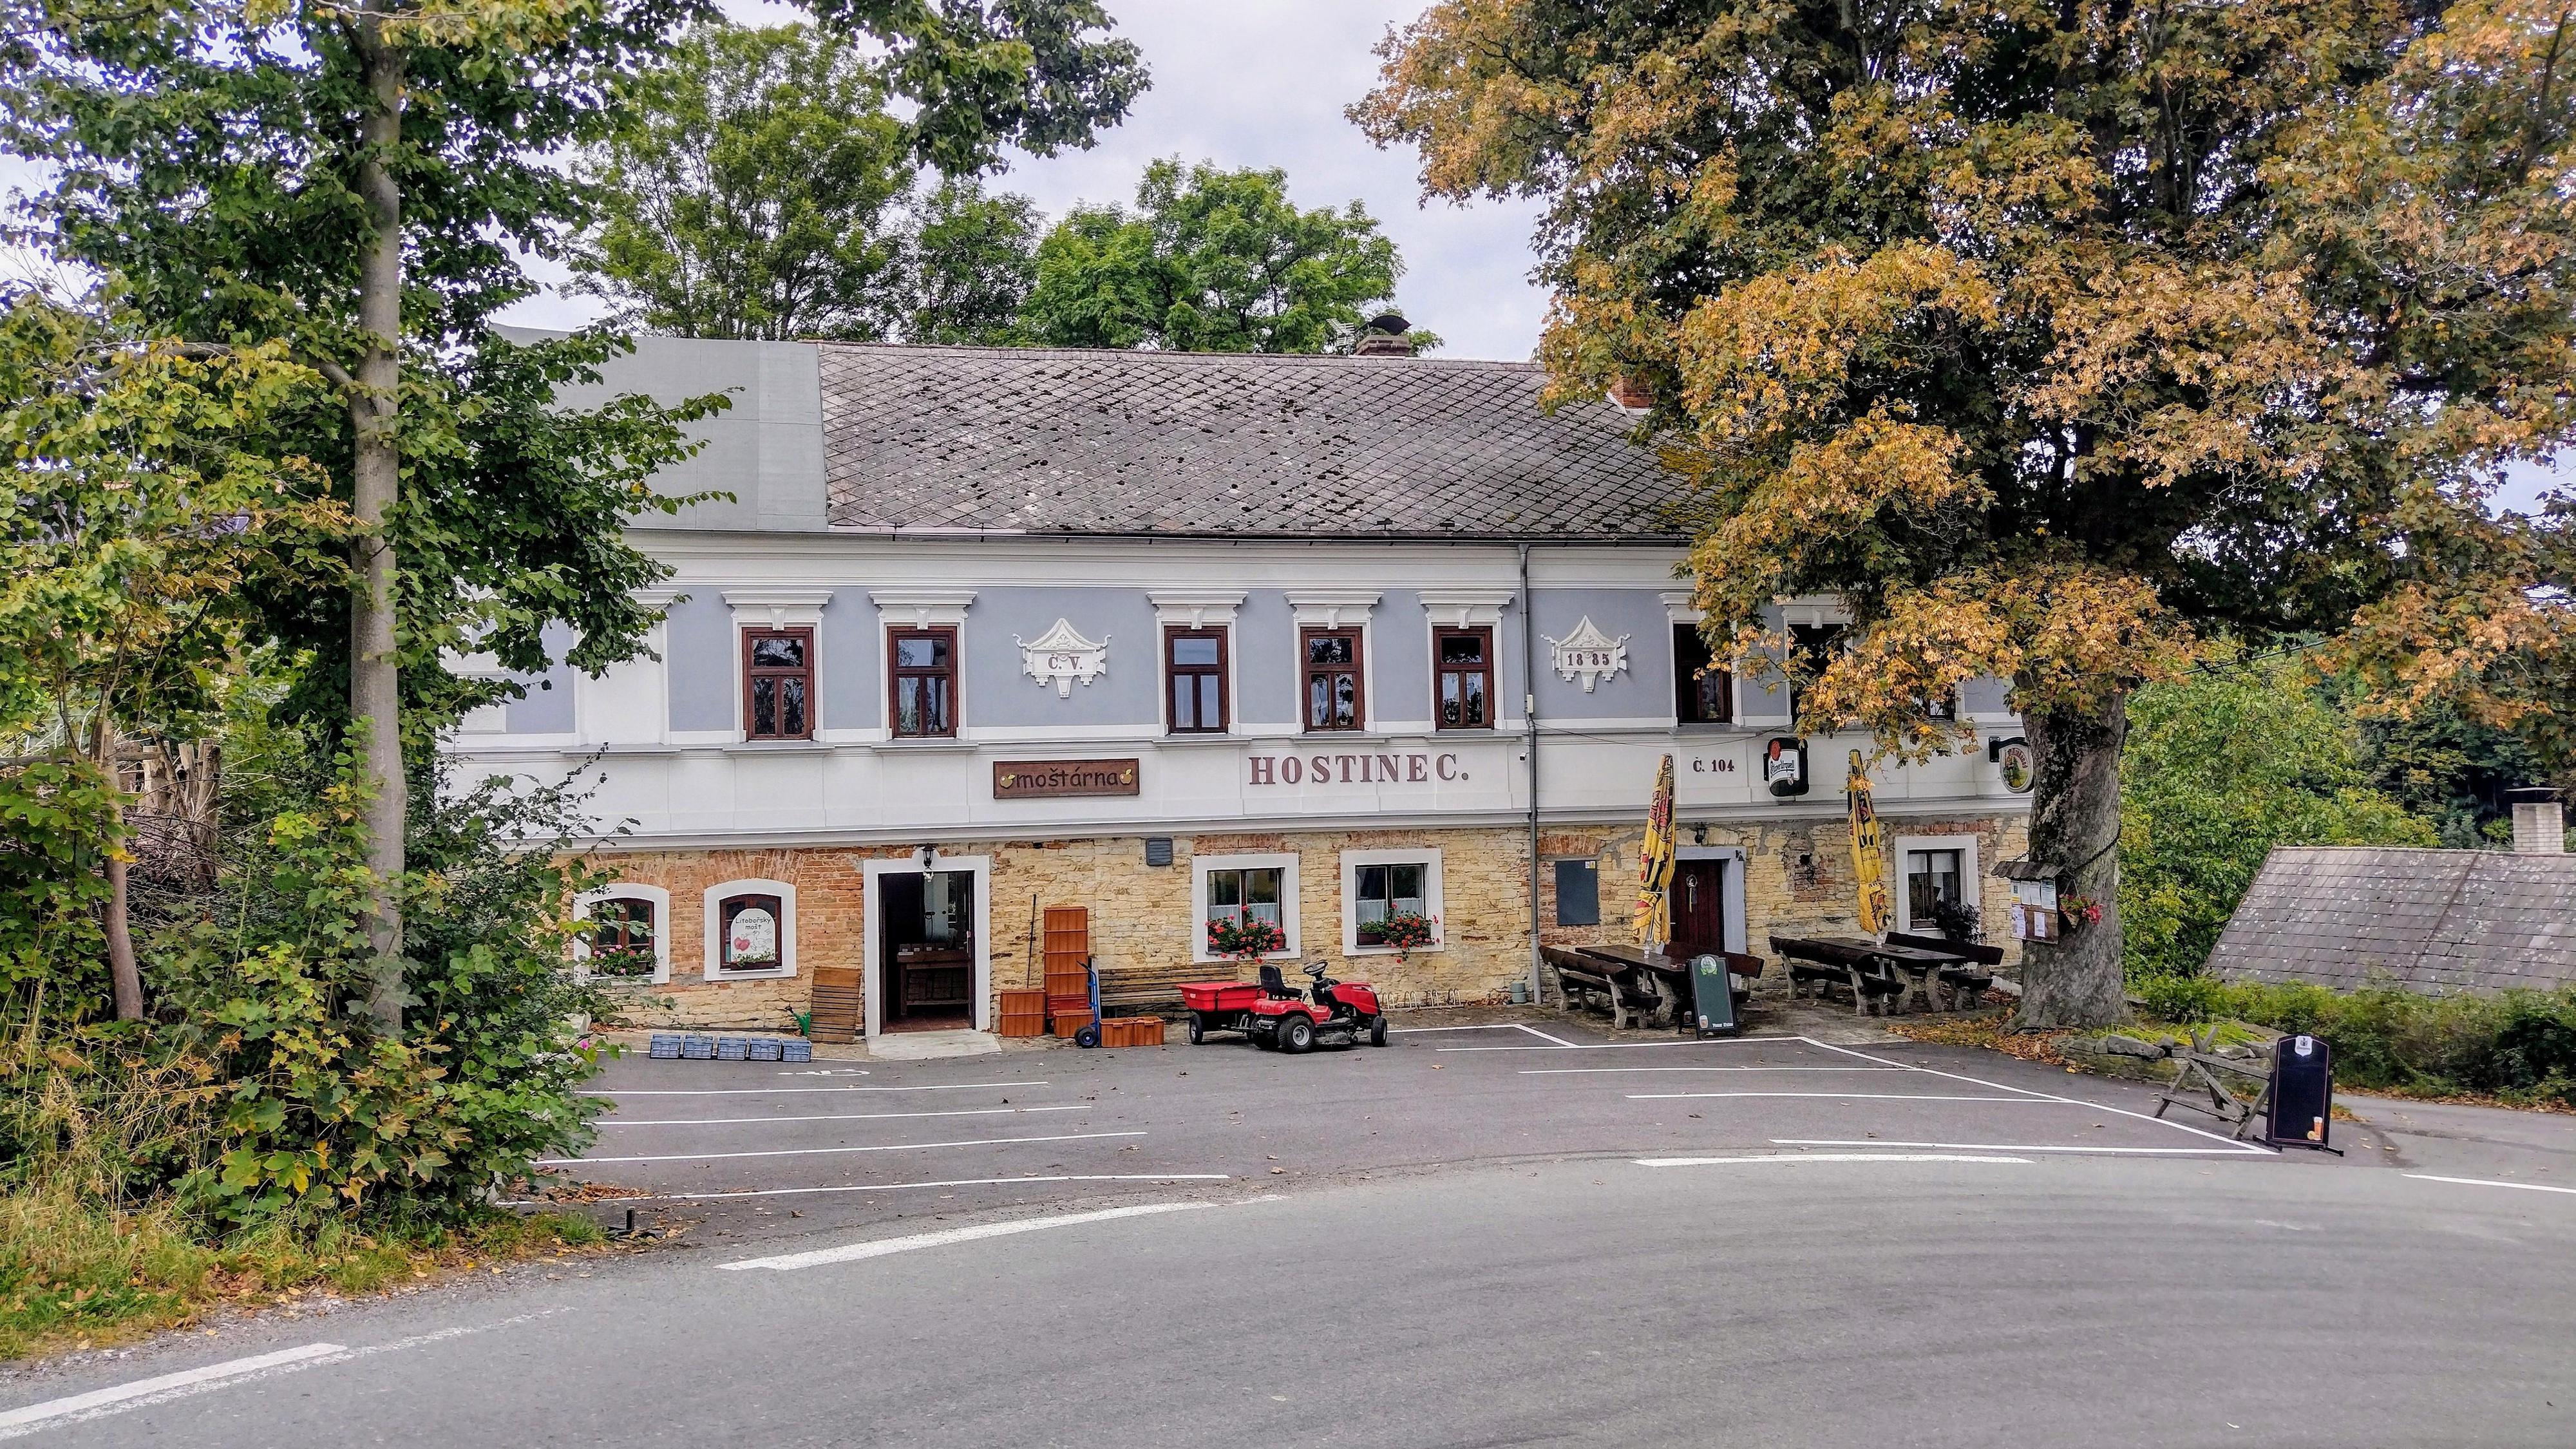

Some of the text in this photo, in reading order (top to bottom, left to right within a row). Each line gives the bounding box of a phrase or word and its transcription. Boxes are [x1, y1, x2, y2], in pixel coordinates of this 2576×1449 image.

[1048, 654, 1083, 670] Č. V.
[1248, 753, 1470, 785] HOSTINEC.
[1692, 757, 1735, 772] Č. 104
[1016, 766, 1119, 789] moštárna
[735, 916, 772, 925] Litobořský
